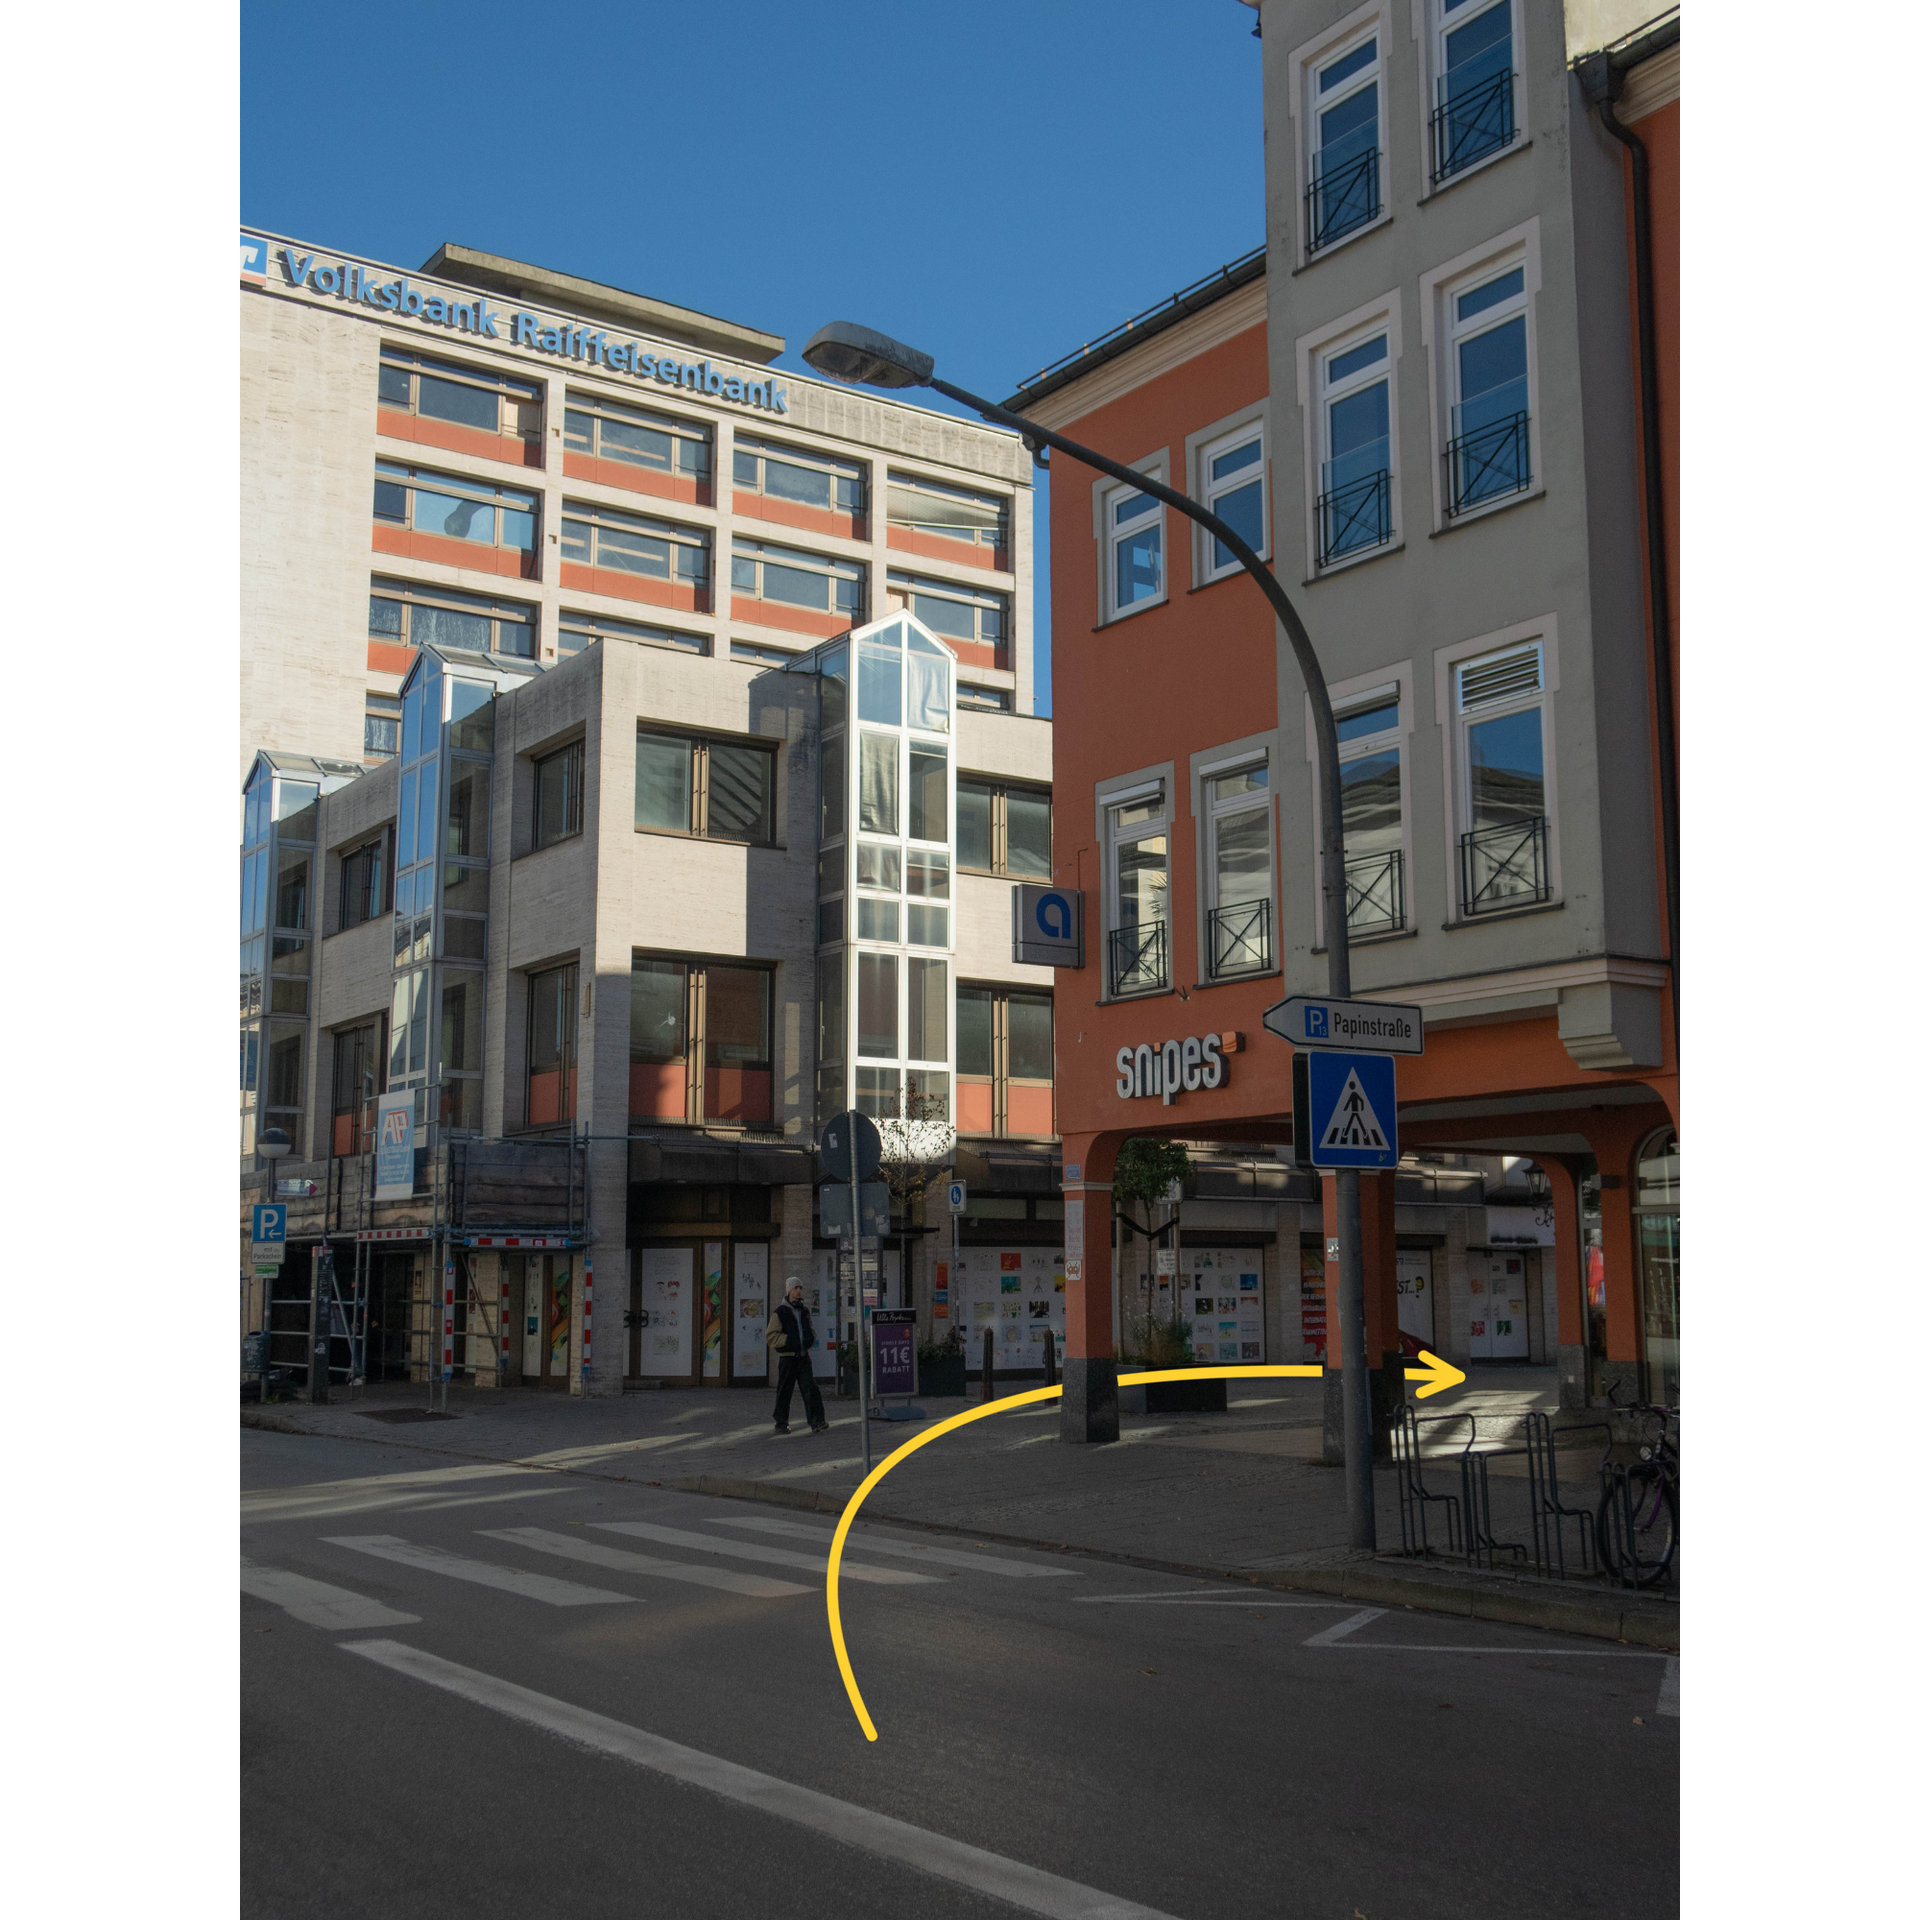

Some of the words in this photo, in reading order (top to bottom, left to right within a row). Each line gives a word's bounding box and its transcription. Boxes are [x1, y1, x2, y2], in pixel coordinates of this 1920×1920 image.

[284, 248, 498, 338] Volksbank
[516, 311, 788, 412] Raiffeisenbank
[1310, 1010, 1323, 1034] P
[1319, 1026, 1327, 1036] 13
[1334, 1013, 1411, 1039] Papinstraße
[1117, 1033, 1222, 1105] snipes
[260, 1209, 279, 1239] P
[880, 1346, 910, 1365] 11€
[882, 1365, 910, 1374] RABATT
